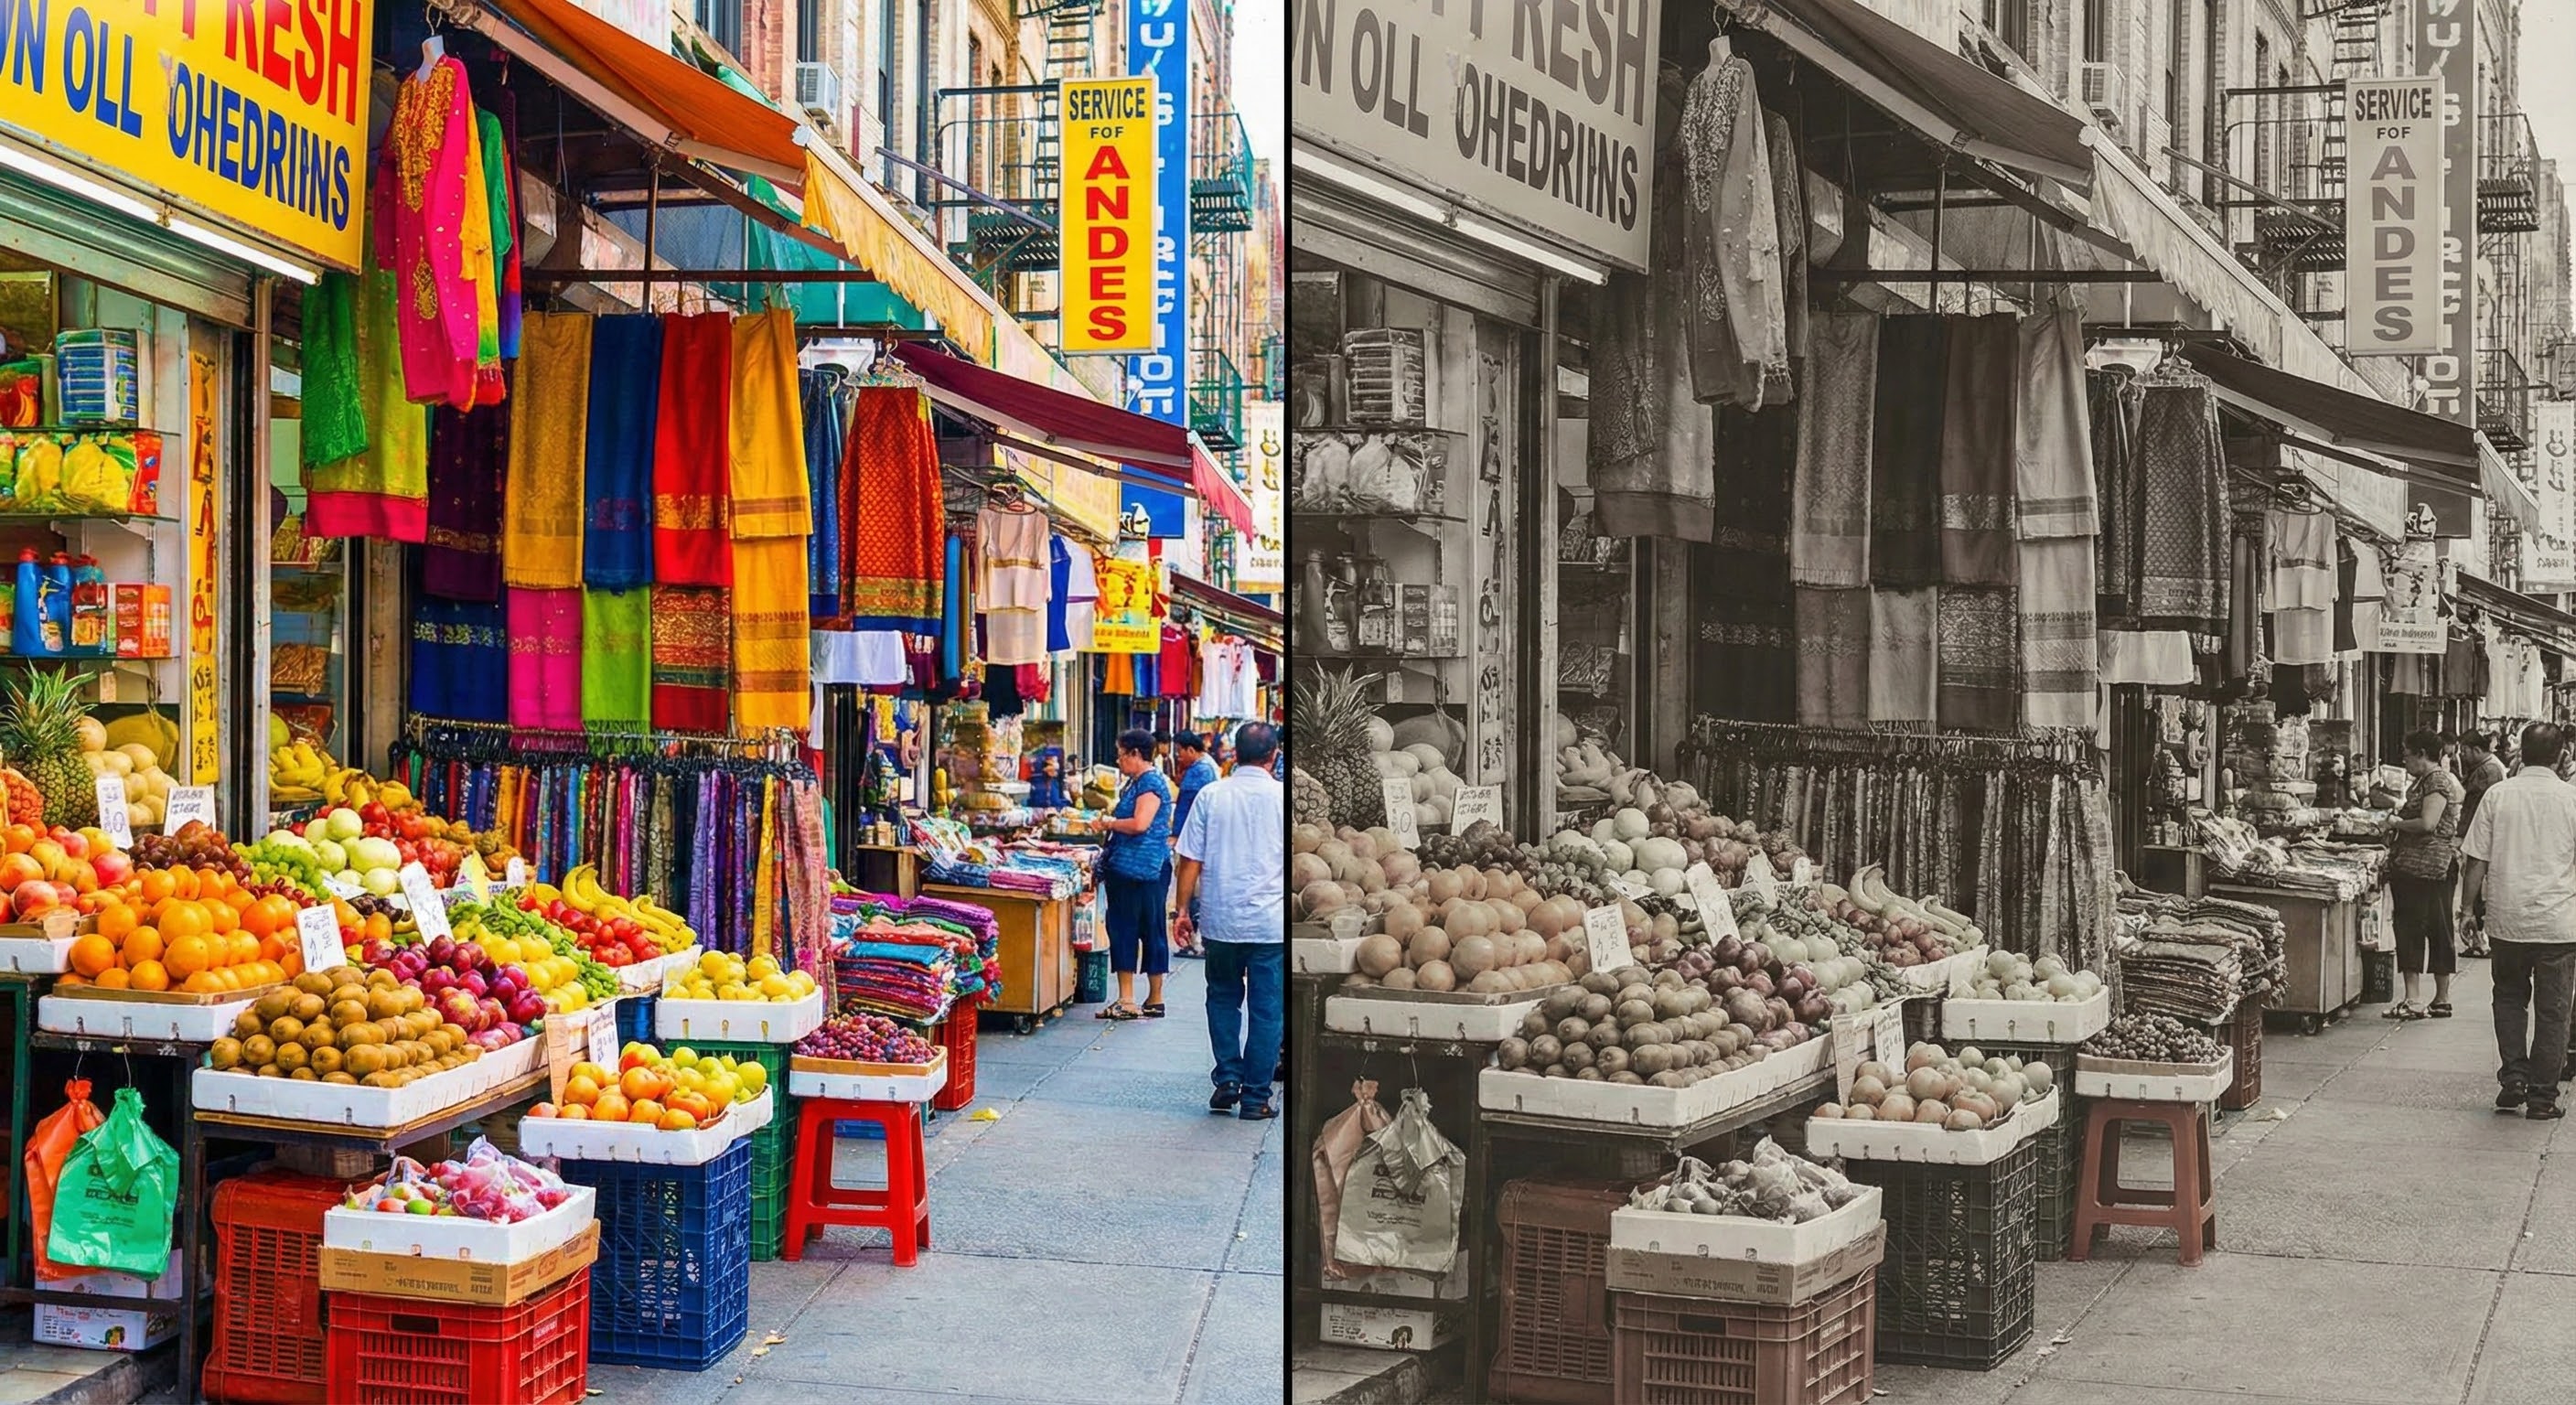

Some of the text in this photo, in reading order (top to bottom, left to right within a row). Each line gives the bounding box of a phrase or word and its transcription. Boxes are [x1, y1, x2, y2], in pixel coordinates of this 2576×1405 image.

[63, 6, 143, 139] OLL
[182, 0, 361, 126] RESH
[1068, 87, 1145, 122] SERVICE
[1351, 7, 1429, 140] OLL
[1469, 0, 1647, 126] RESH
[2355, 87, 2432, 122] SERVICE
[1084, 145, 1131, 341] ANDES
[2369, 145, 2417, 342] ANDES
